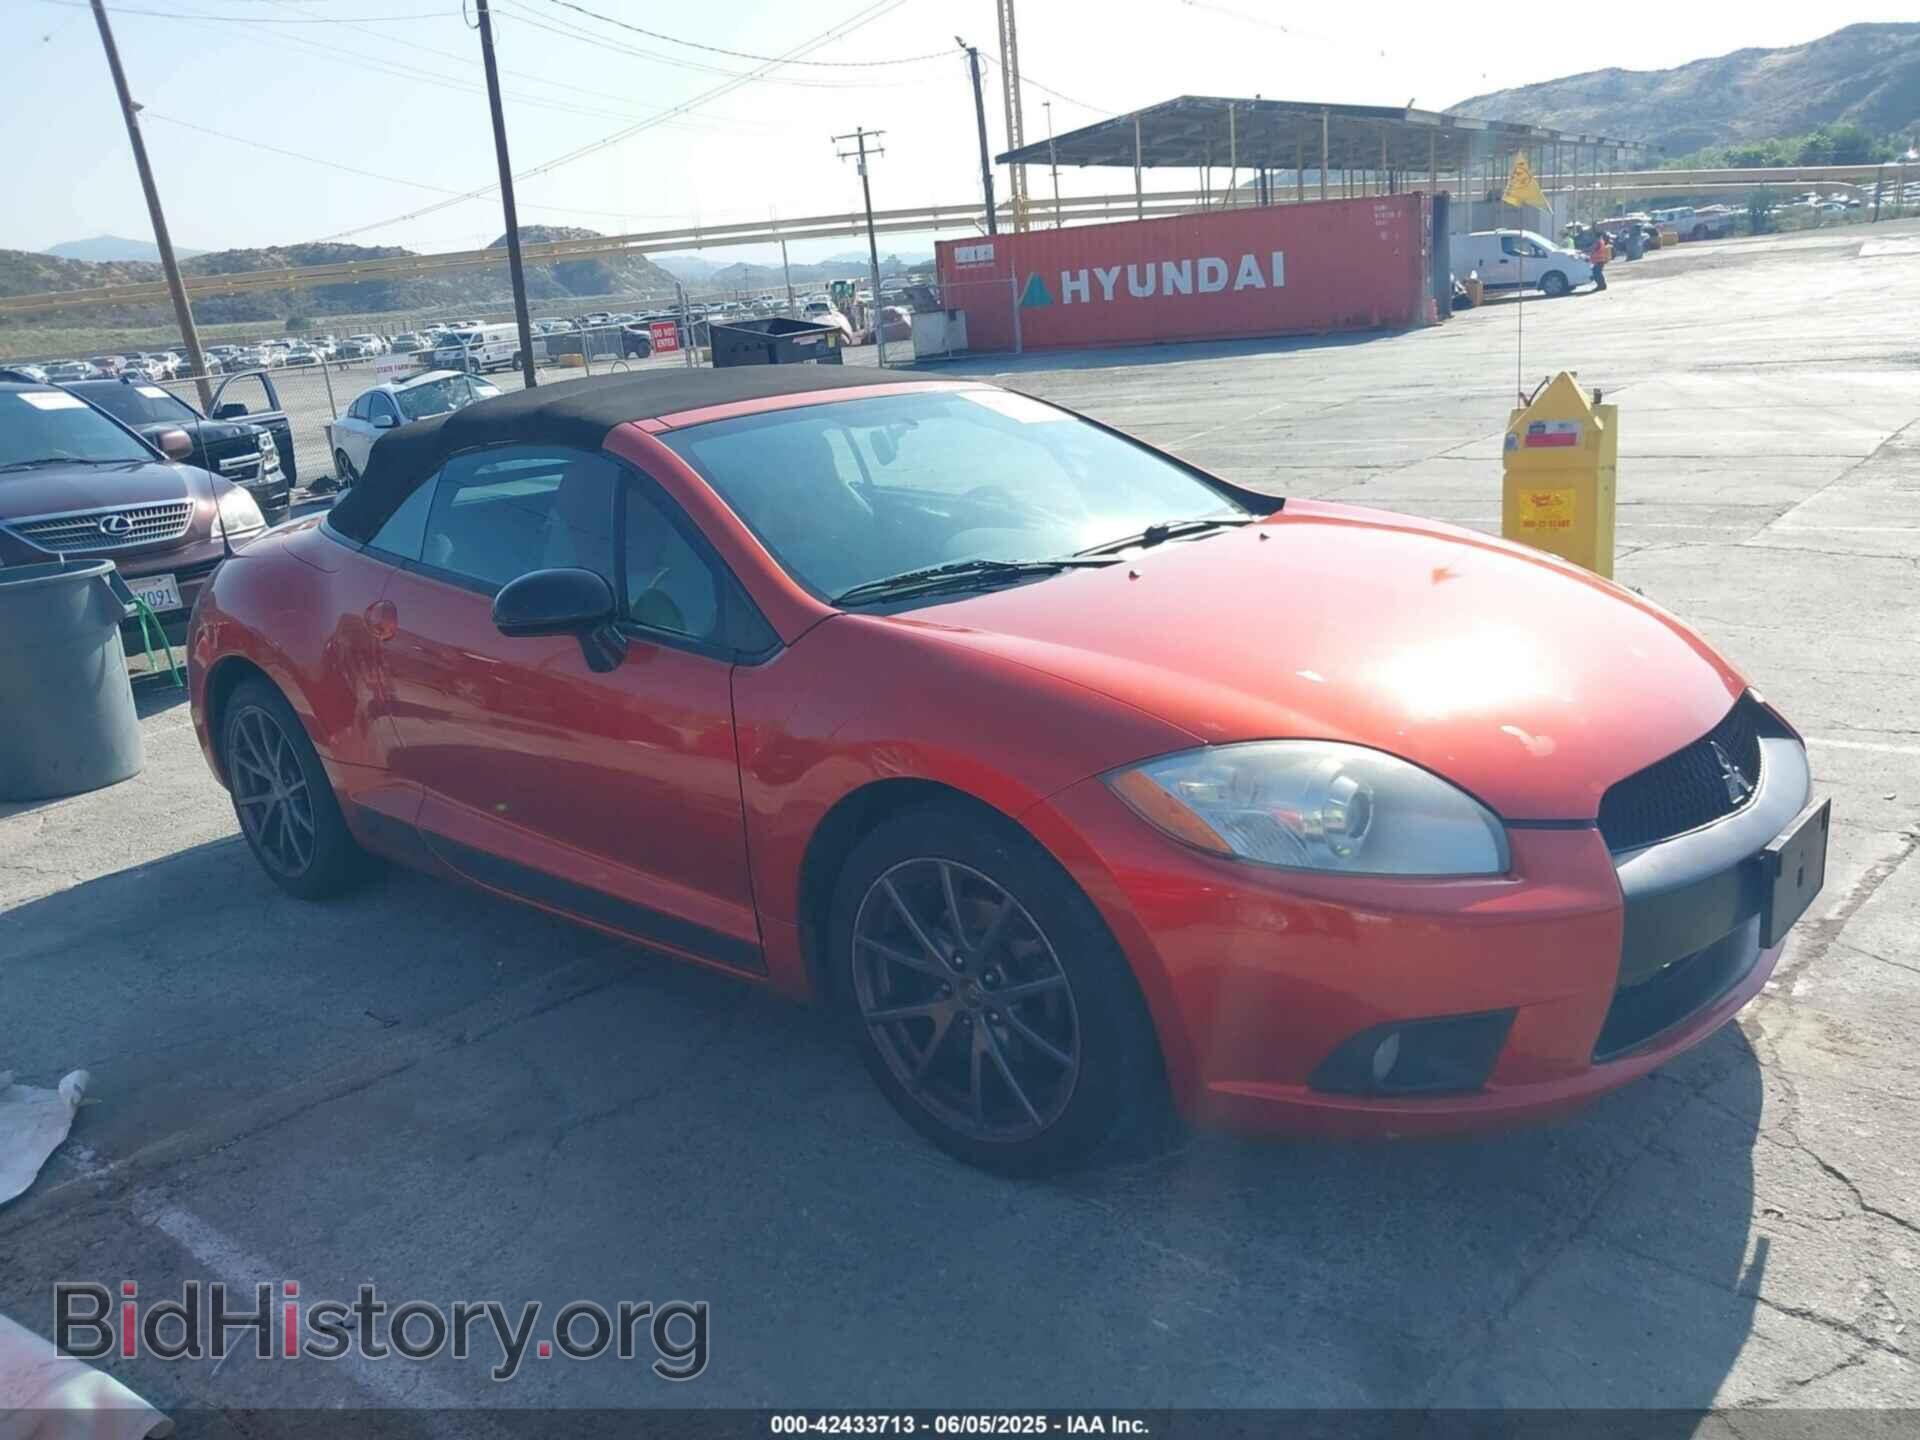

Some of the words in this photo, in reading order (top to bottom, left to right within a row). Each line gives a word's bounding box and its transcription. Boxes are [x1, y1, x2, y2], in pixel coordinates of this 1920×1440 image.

[1061, 251, 1285, 305] HYUNDAI
[654, 328, 663, 337] DO
[664, 327, 675, 336] NOT
[656, 338, 674, 348] ENTER
